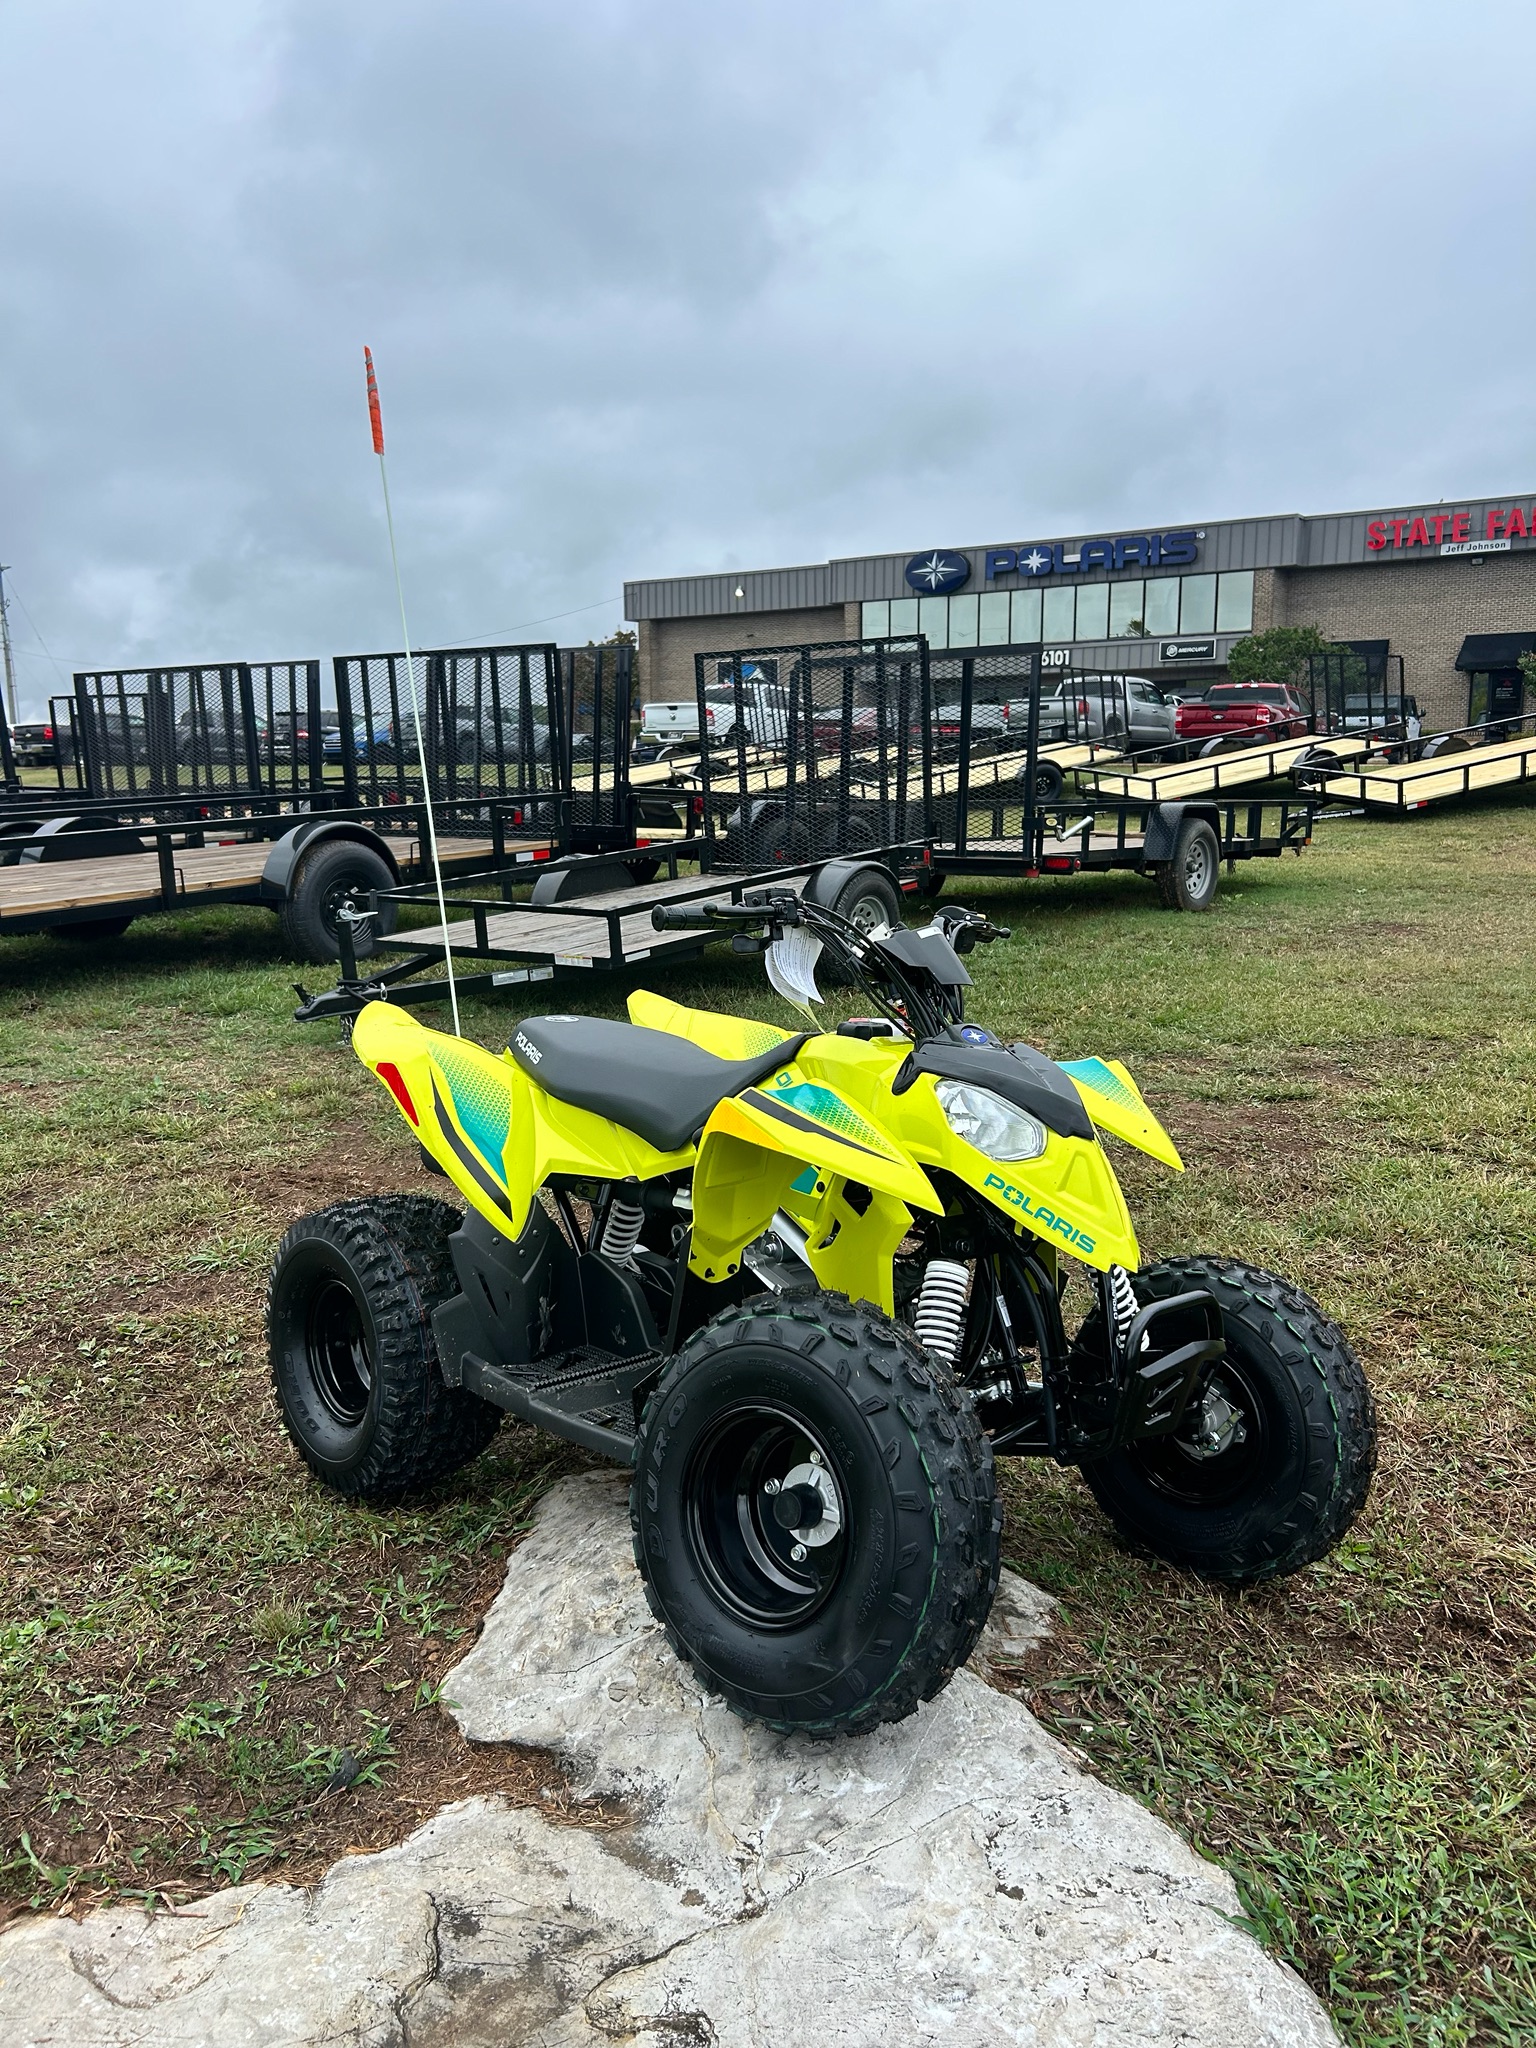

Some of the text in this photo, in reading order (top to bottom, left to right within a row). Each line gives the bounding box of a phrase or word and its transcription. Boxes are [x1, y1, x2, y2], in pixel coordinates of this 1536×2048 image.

[1367, 507, 1536, 550] STATE FA
[1446, 541, 1507, 553] Jeff Johnson
[985, 531, 1199, 581] POLARIS
[1041, 650, 1070, 666] 6101
[515, 1031, 543, 1065] POLARIS
[984, 1173, 1096, 1254] POLARIS
[646, 1392, 688, 1559] DURO
